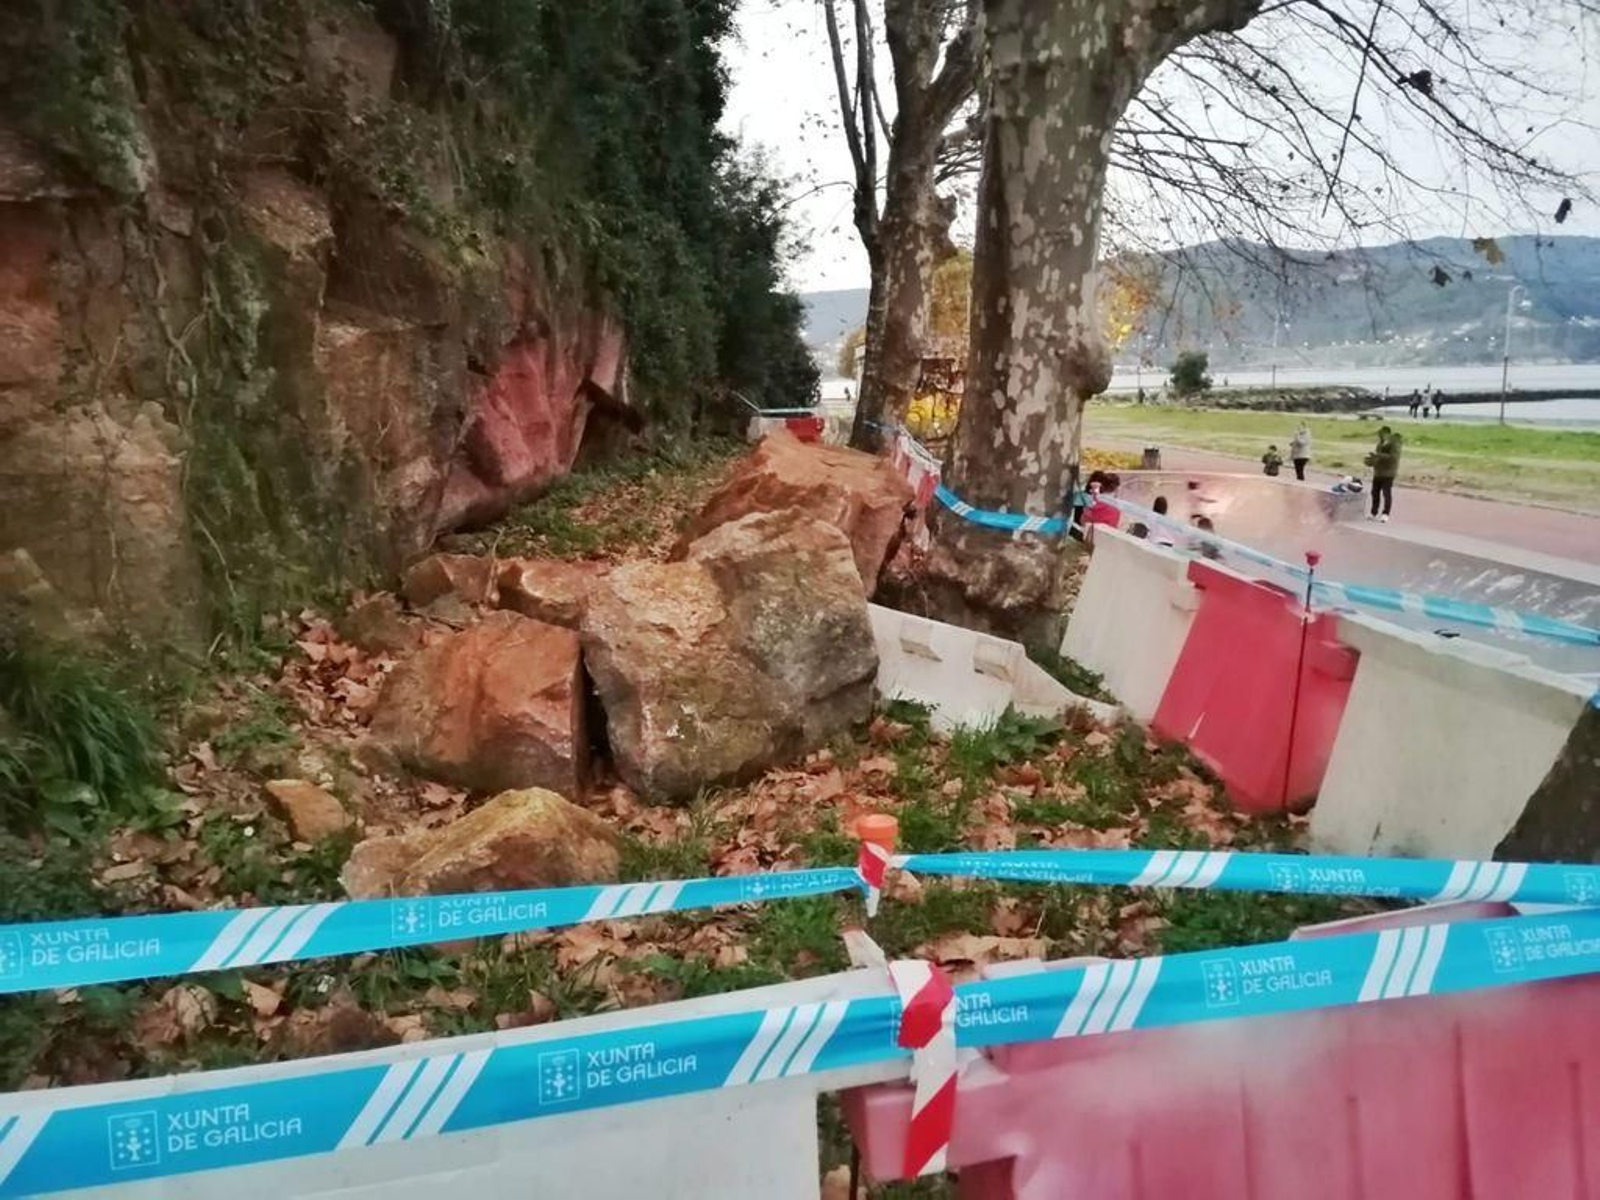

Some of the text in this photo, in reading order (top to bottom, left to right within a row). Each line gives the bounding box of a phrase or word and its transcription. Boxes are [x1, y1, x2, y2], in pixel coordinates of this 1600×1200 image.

[1308, 868, 1366, 882] XUNTA
[438, 902, 547, 927] DE GALICIA
[30, 927, 110, 946] XUNTA
[1519, 925, 1571, 943] XUNTA
[31, 938, 160, 966] DE GALICIA
[1524, 944, 1545, 961] DE
[1240, 955, 1296, 977] XUNTA
[1242, 969, 1333, 995] DE GALICIA
[956, 1006, 1028, 1027] GALICIA
[587, 1042, 655, 1069] XUNTA
[587, 1054, 697, 1088] DE GALICIA
[168, 1103, 249, 1132] XUNTA
[168, 1117, 301, 1152] DE GALICIA
